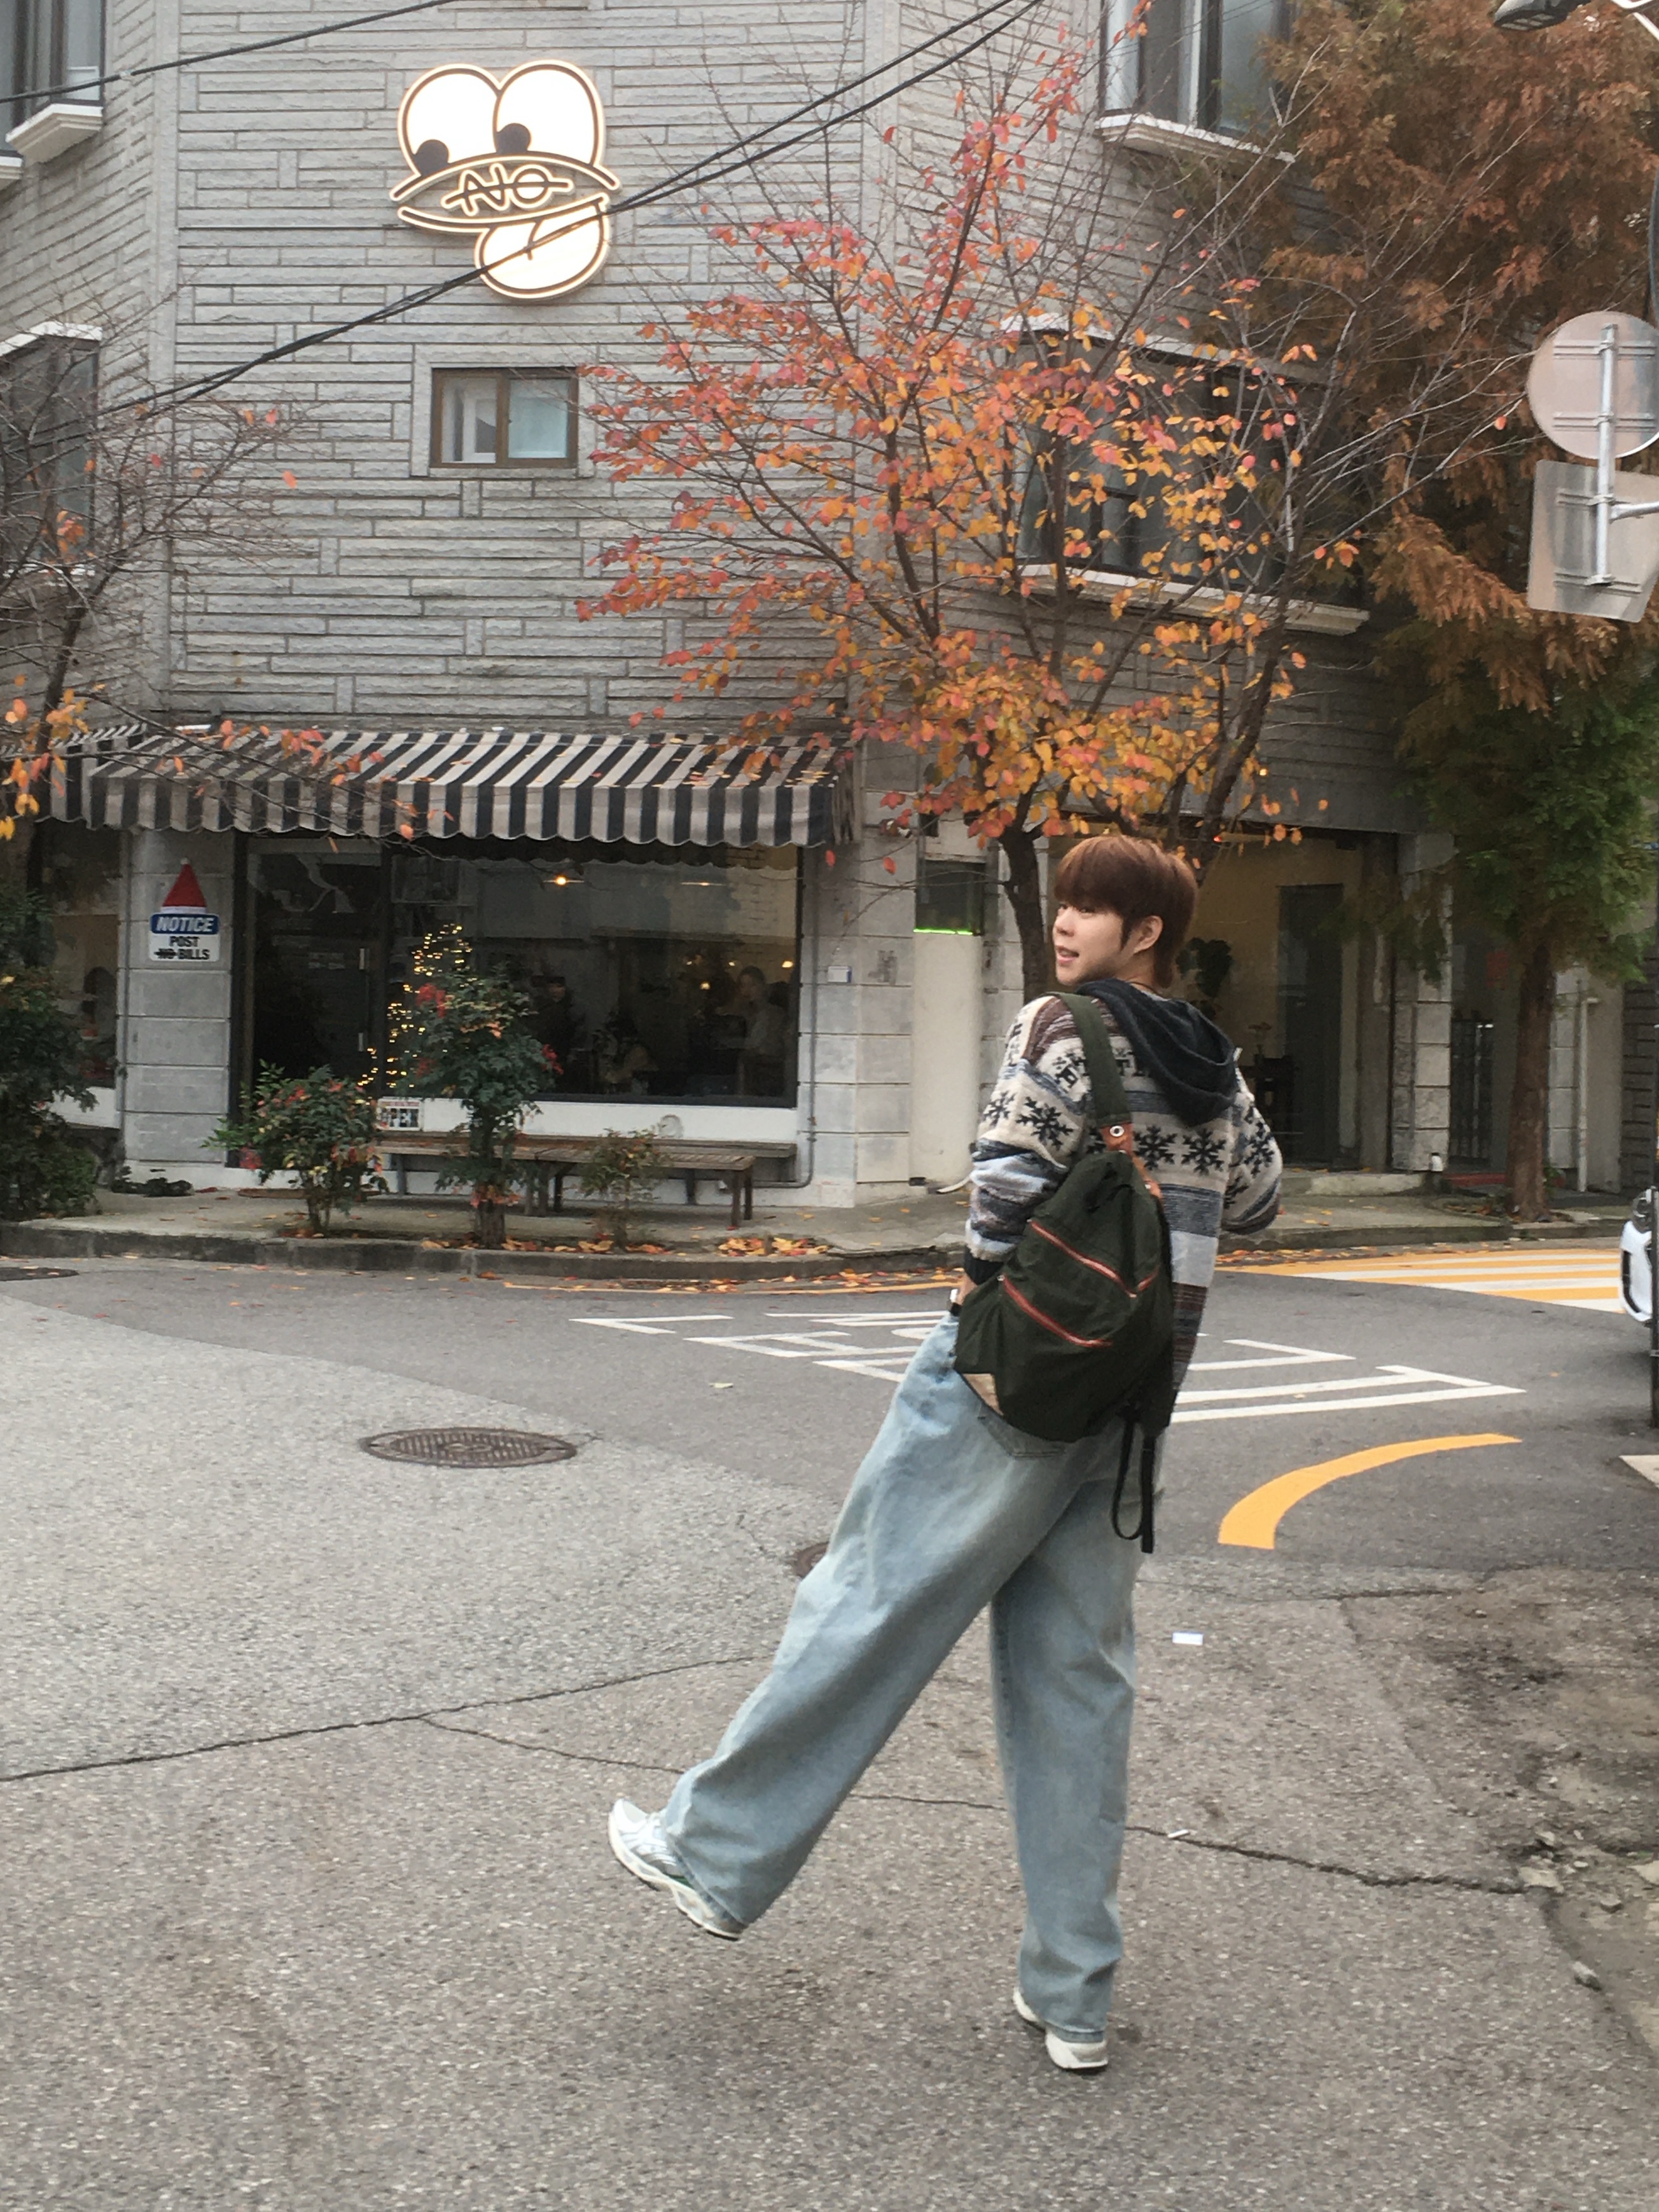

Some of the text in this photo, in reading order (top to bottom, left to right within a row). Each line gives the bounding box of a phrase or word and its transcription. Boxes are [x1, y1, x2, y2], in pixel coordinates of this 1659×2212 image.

[156, 916, 214, 932] NOTICE
[169, 936, 200, 947] POST
[177, 948, 211, 960] BILLS
